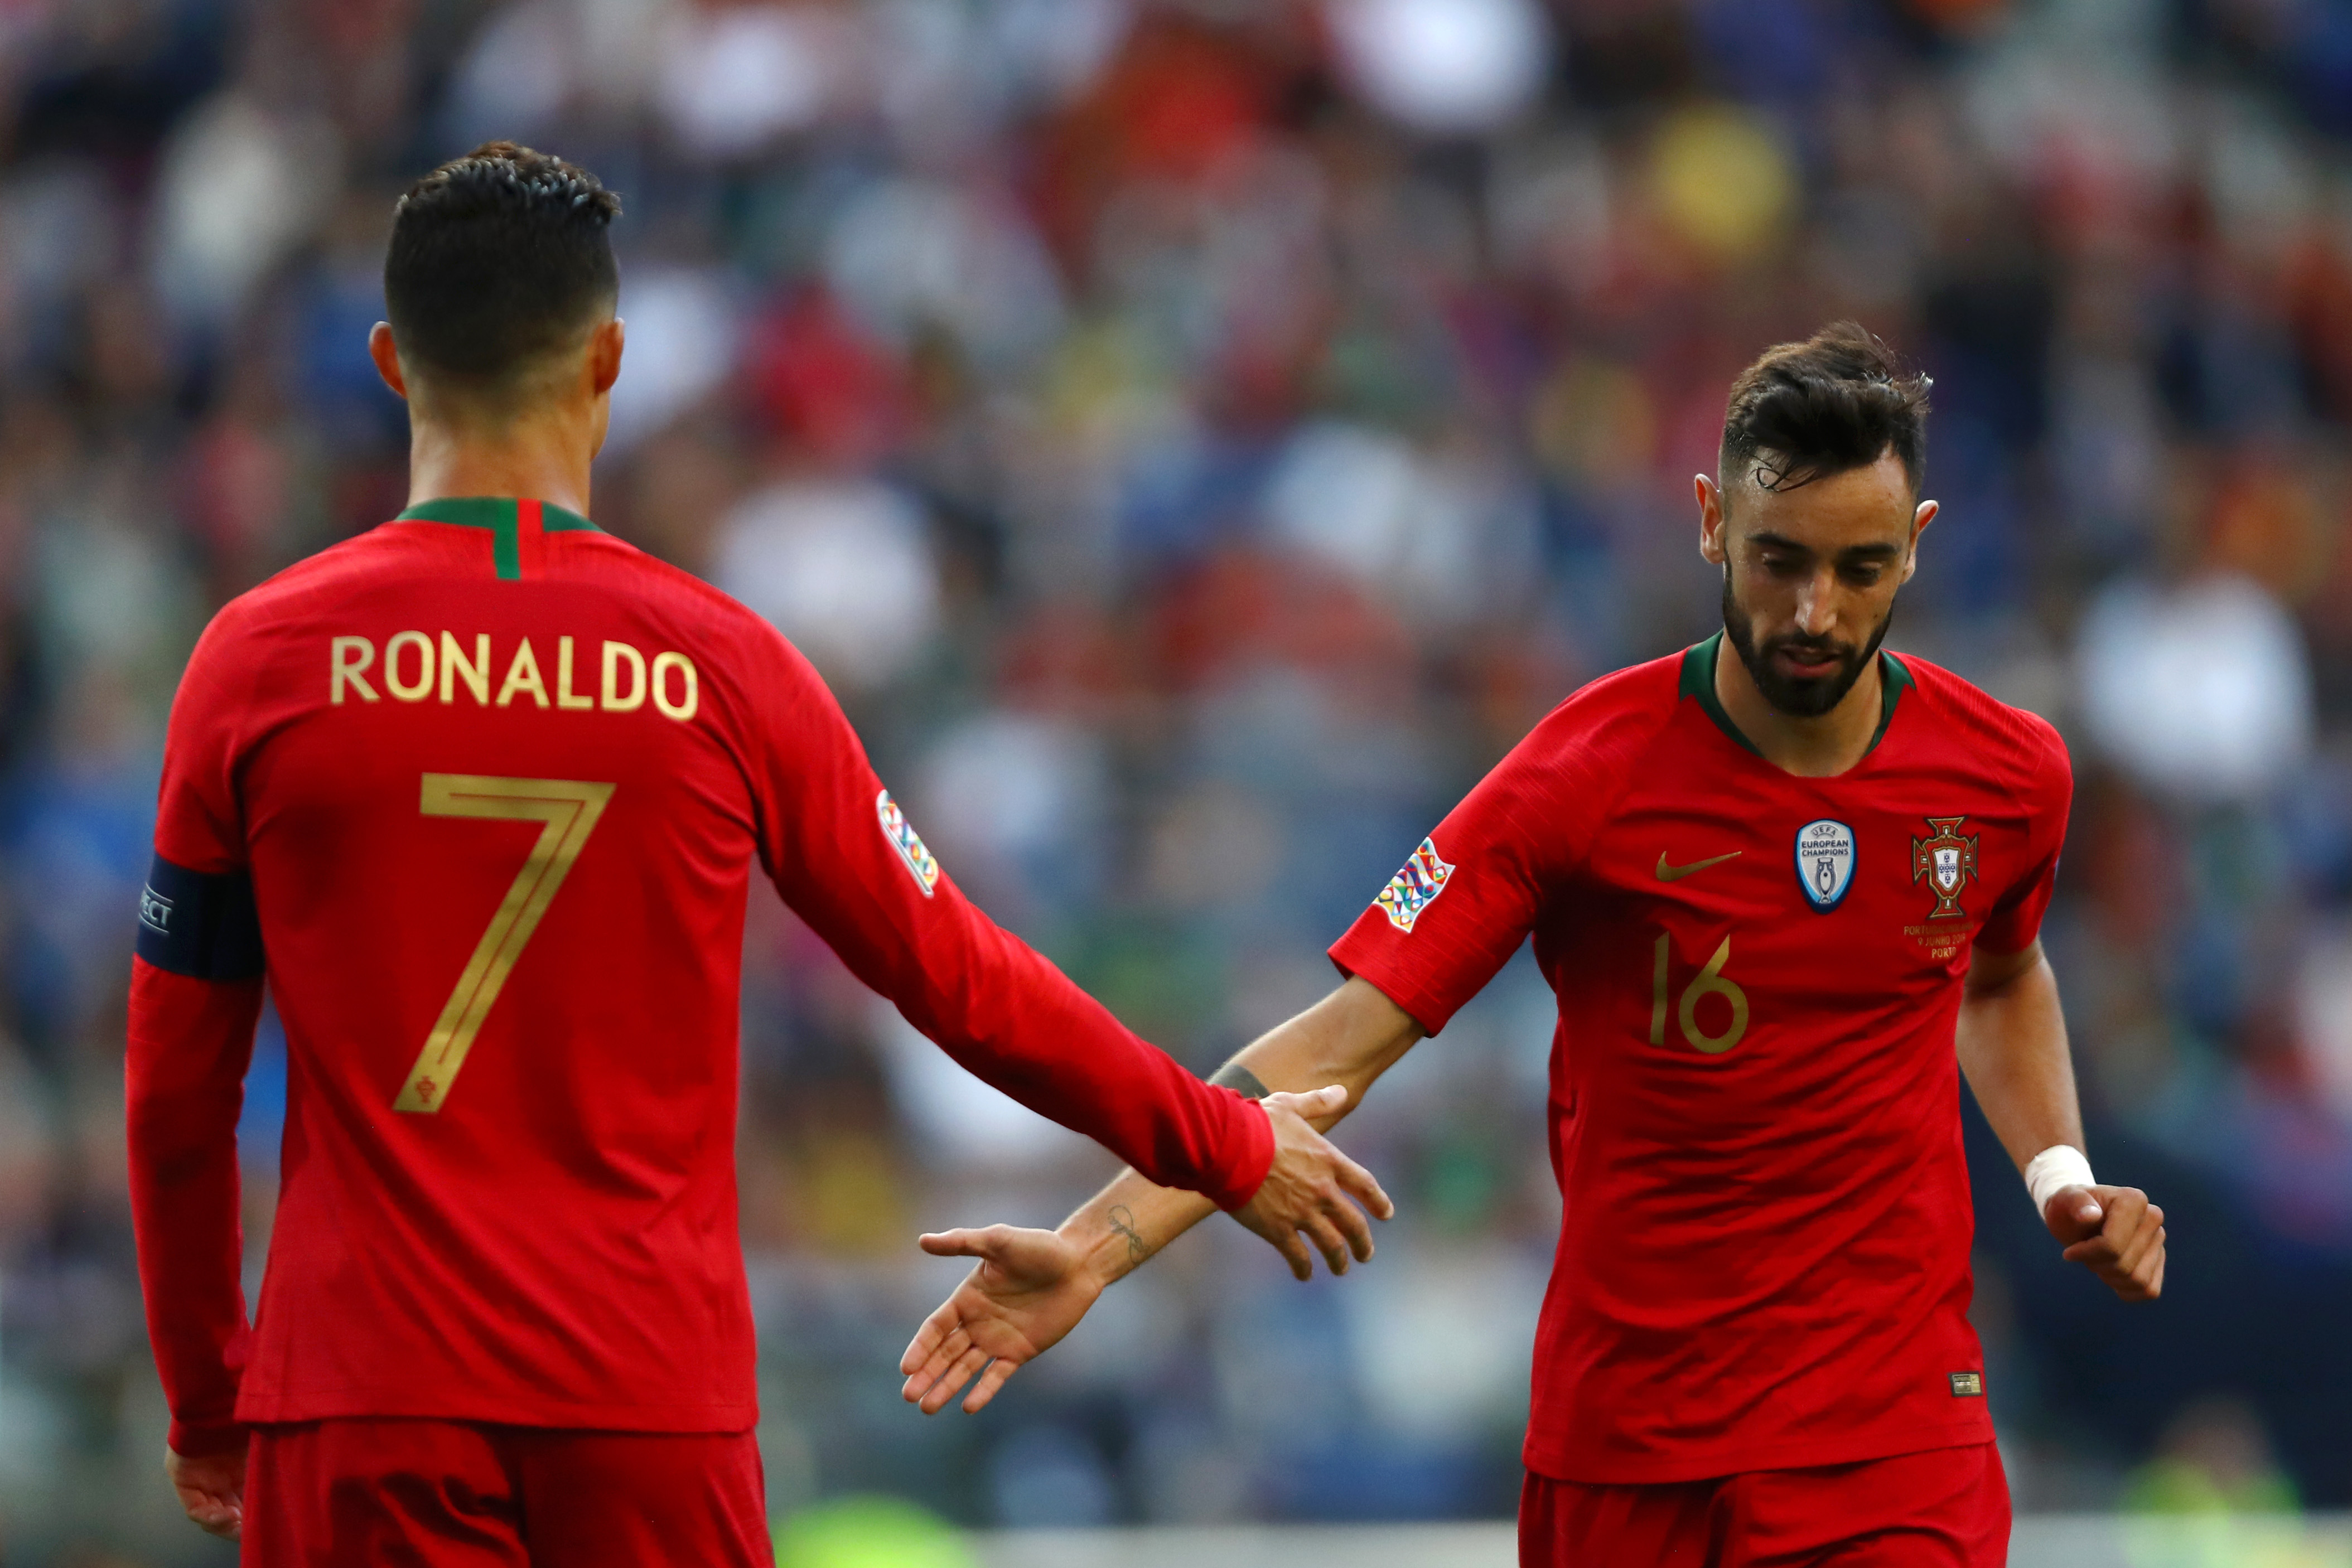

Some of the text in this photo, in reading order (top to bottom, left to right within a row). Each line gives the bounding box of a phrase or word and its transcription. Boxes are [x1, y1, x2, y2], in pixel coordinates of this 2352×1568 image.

[331, 630, 698, 721] RONALDO
[1812, 826, 1837, 836] UEFA
[1802, 839, 1849, 848] EUROPEAN
[1802, 848, 1849, 856] CHAMPIONS
[140, 891, 172, 926] ECT
[392, 772, 617, 1114] 7
[1931, 946, 1957, 959] PORTO
[1649, 930, 1749, 1054] 16
